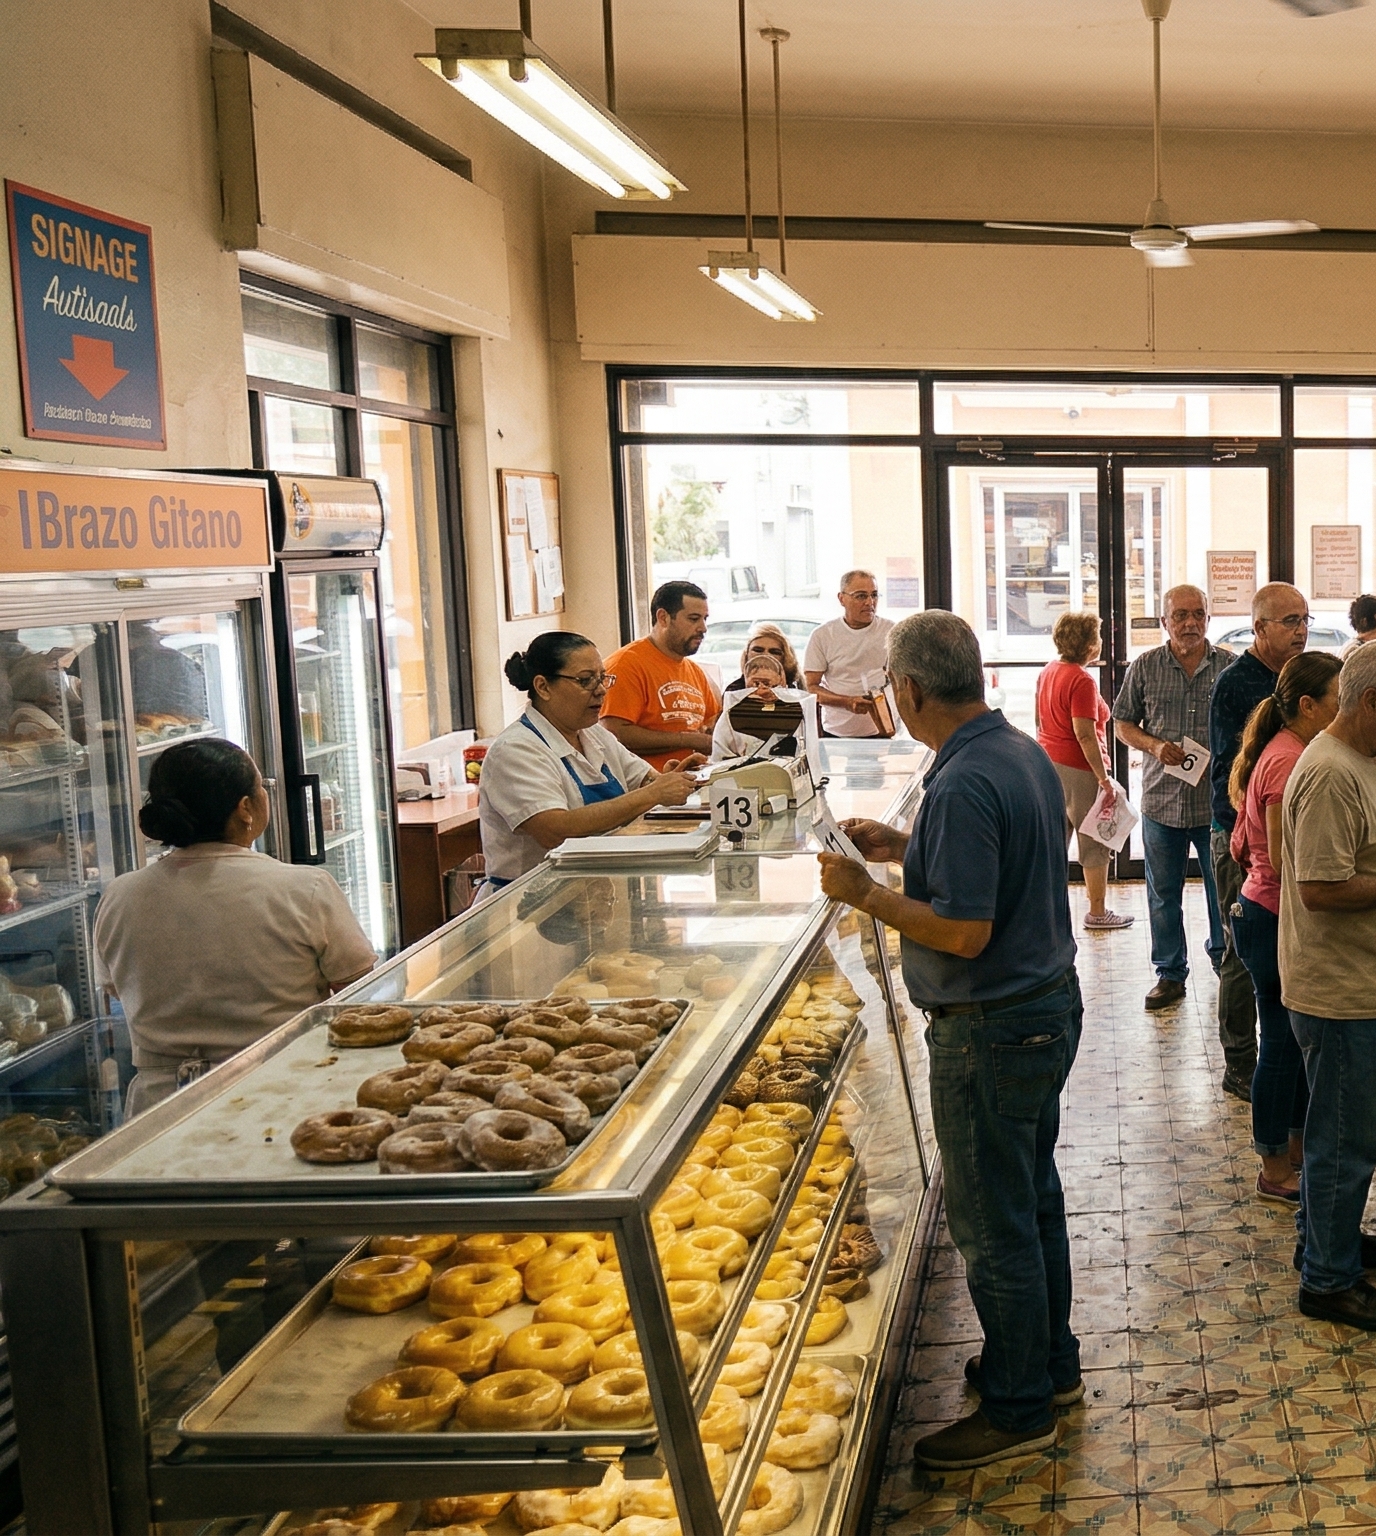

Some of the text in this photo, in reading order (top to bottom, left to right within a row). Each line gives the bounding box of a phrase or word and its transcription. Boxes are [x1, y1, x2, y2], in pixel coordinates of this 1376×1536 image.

[31, 213, 139, 283] SIGNAGE
[37, 491, 138, 550] Brazo
[149, 495, 242, 549] Gitano
[1181, 754, 1198, 771] 6
[716, 796, 752, 828] 13
